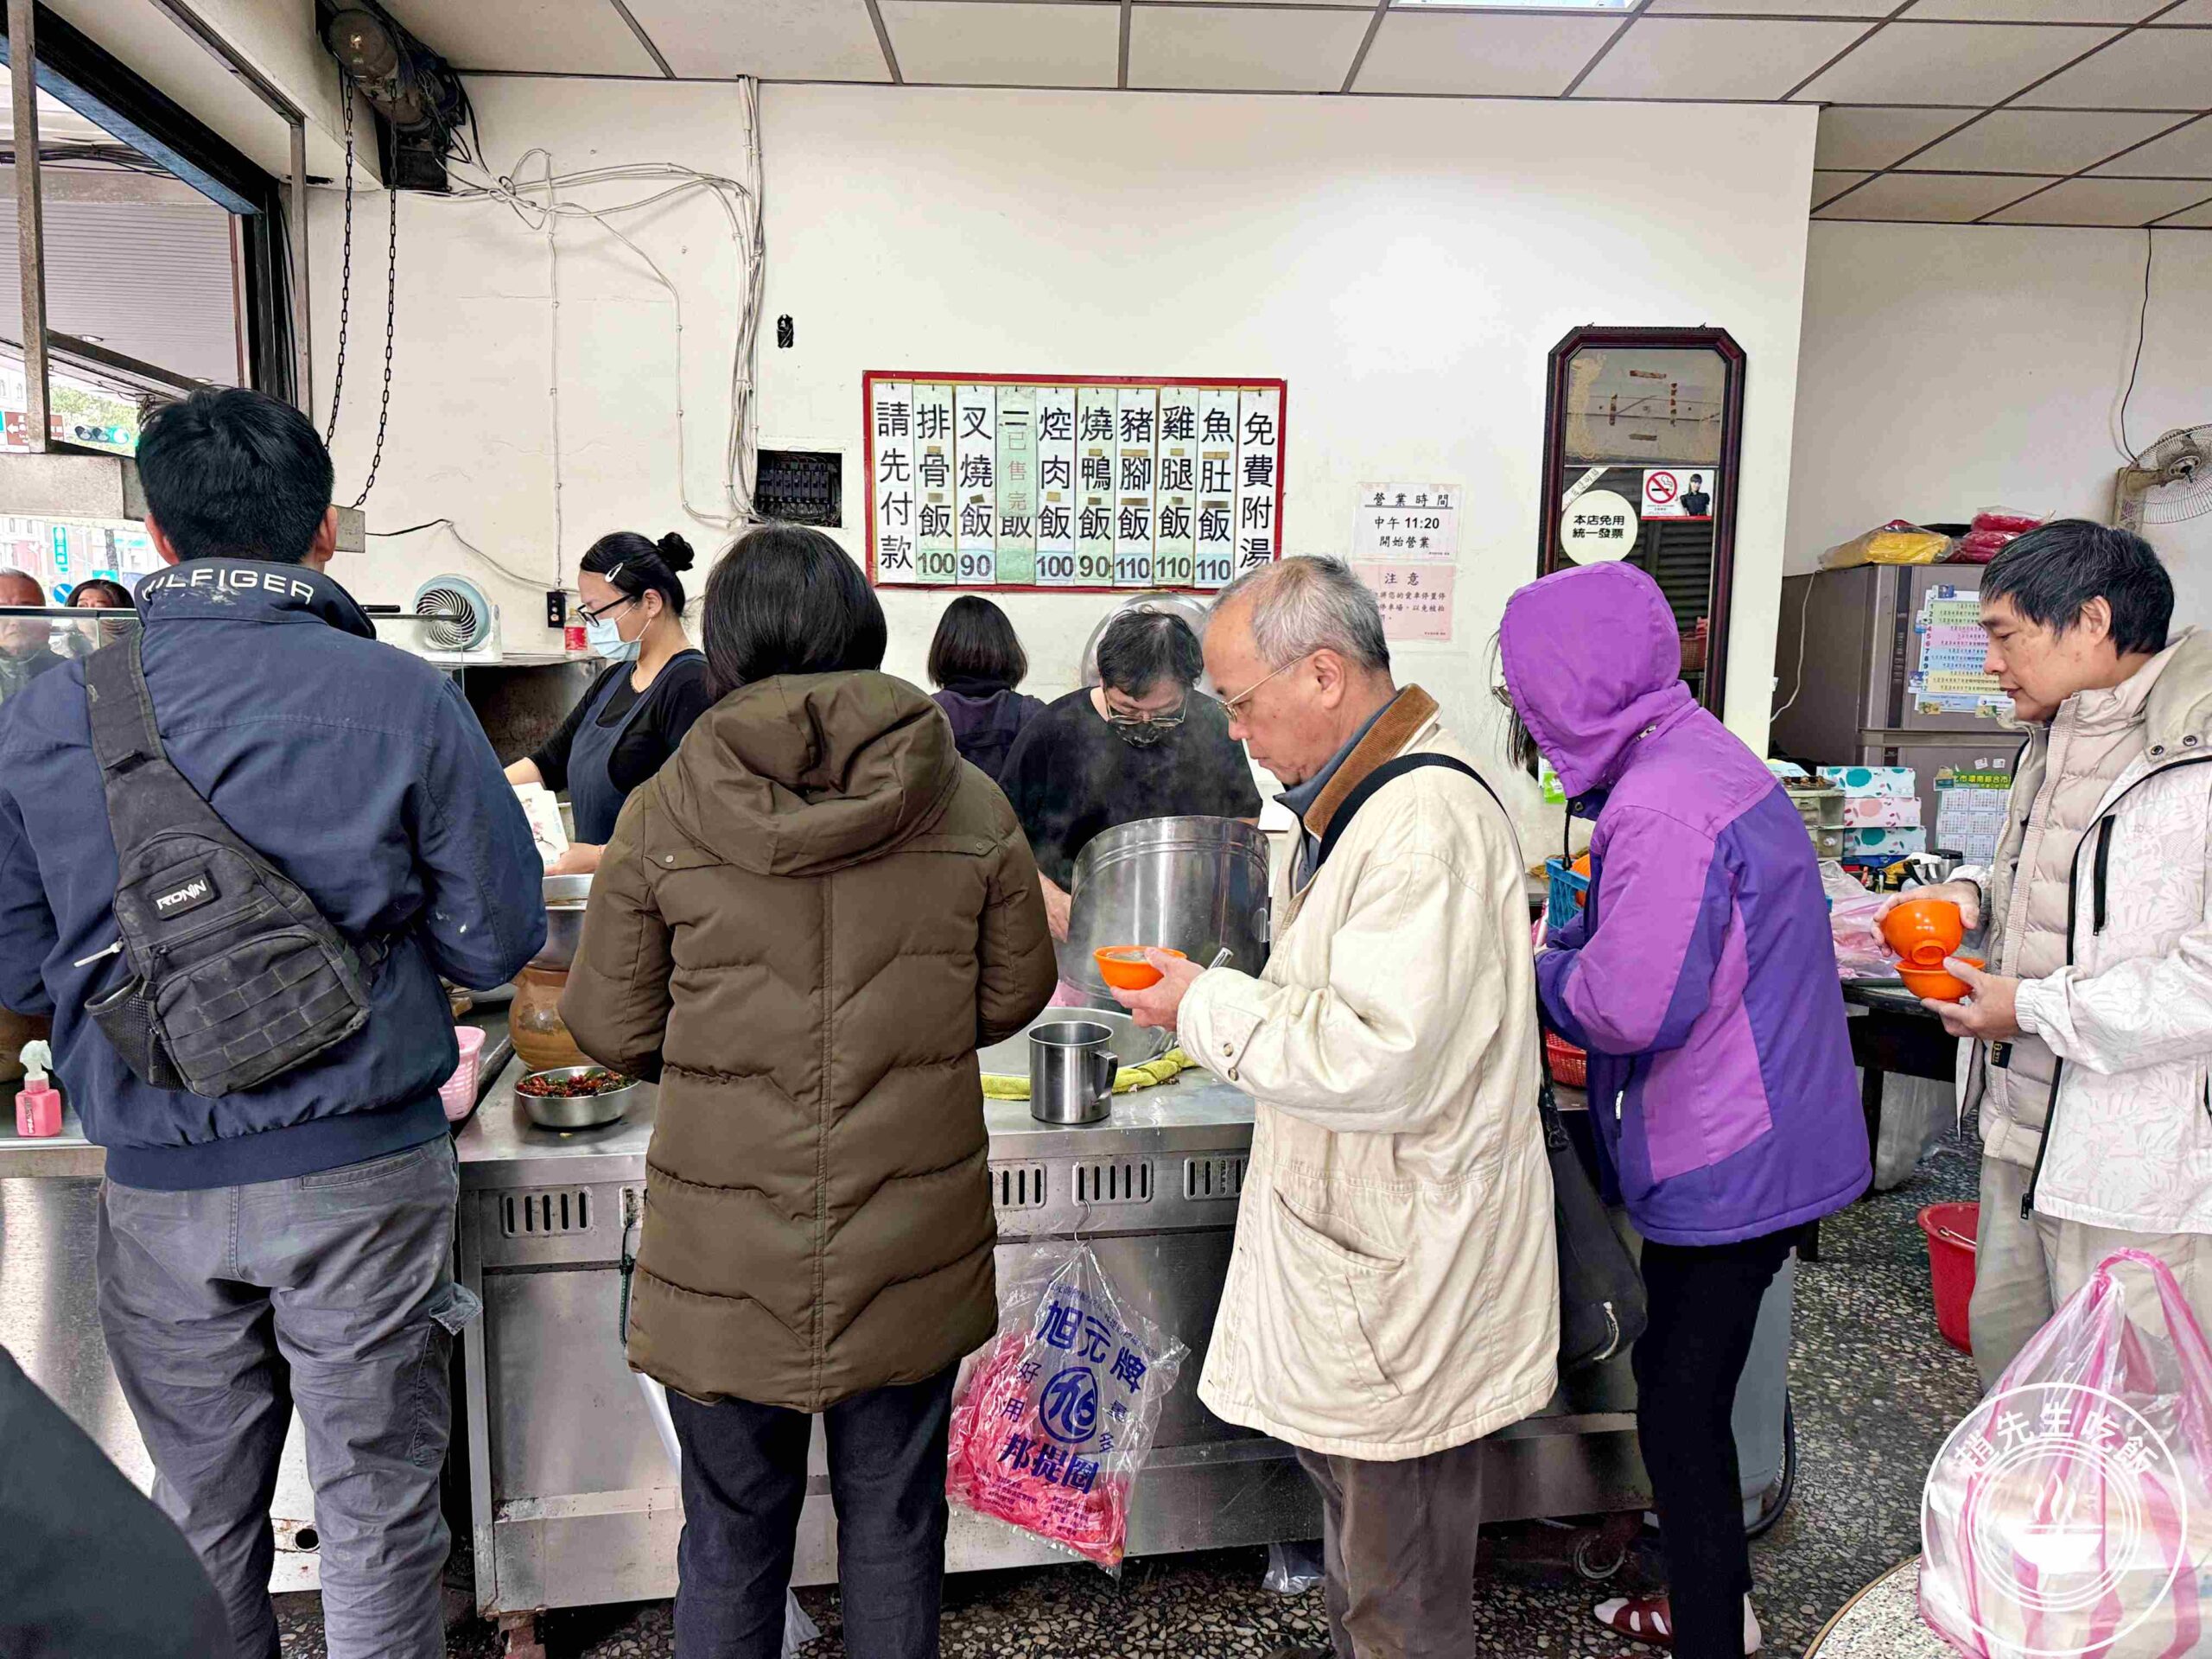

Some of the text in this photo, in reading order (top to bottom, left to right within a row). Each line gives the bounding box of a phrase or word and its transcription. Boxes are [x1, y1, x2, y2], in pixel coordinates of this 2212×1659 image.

[916, 404, 953, 538] 排骨飯
[960, 407, 994, 538] 叉燒飯
[1038, 406, 1072, 539] 焢肉飯
[1079, 406, 1114, 541] 燒鴨飯
[1118, 407, 1154, 541] 豬腳飯
[1159, 405, 1195, 540] 雞腿飯
[1198, 407, 1235, 542] 魚肚飯
[876, 402, 913, 569] 請先付款
[1239, 411, 1275, 569] 免費附湯
[1373, 492, 1450, 507] 營業時間
[1374, 516, 1440, 530] 中午 11:20
[1573, 515, 1625, 526] 本店免用
[1379, 536, 1431, 549] 開始營業
[1572, 528, 1624, 539] 統一發票
[918, 553, 956, 574] 100
[961, 554, 993, 576] 90
[1036, 556, 1074, 577] 100
[1079, 556, 1109, 578] 90
[1116, 557, 1150, 579] 110
[1156, 556, 1191, 578] 110
[1196, 560, 1231, 581] 110
[1384, 572, 1420, 586] 注意
[156, 880, 207, 911] RONIN
[1037, 1300, 1147, 1394] 旭元牌
